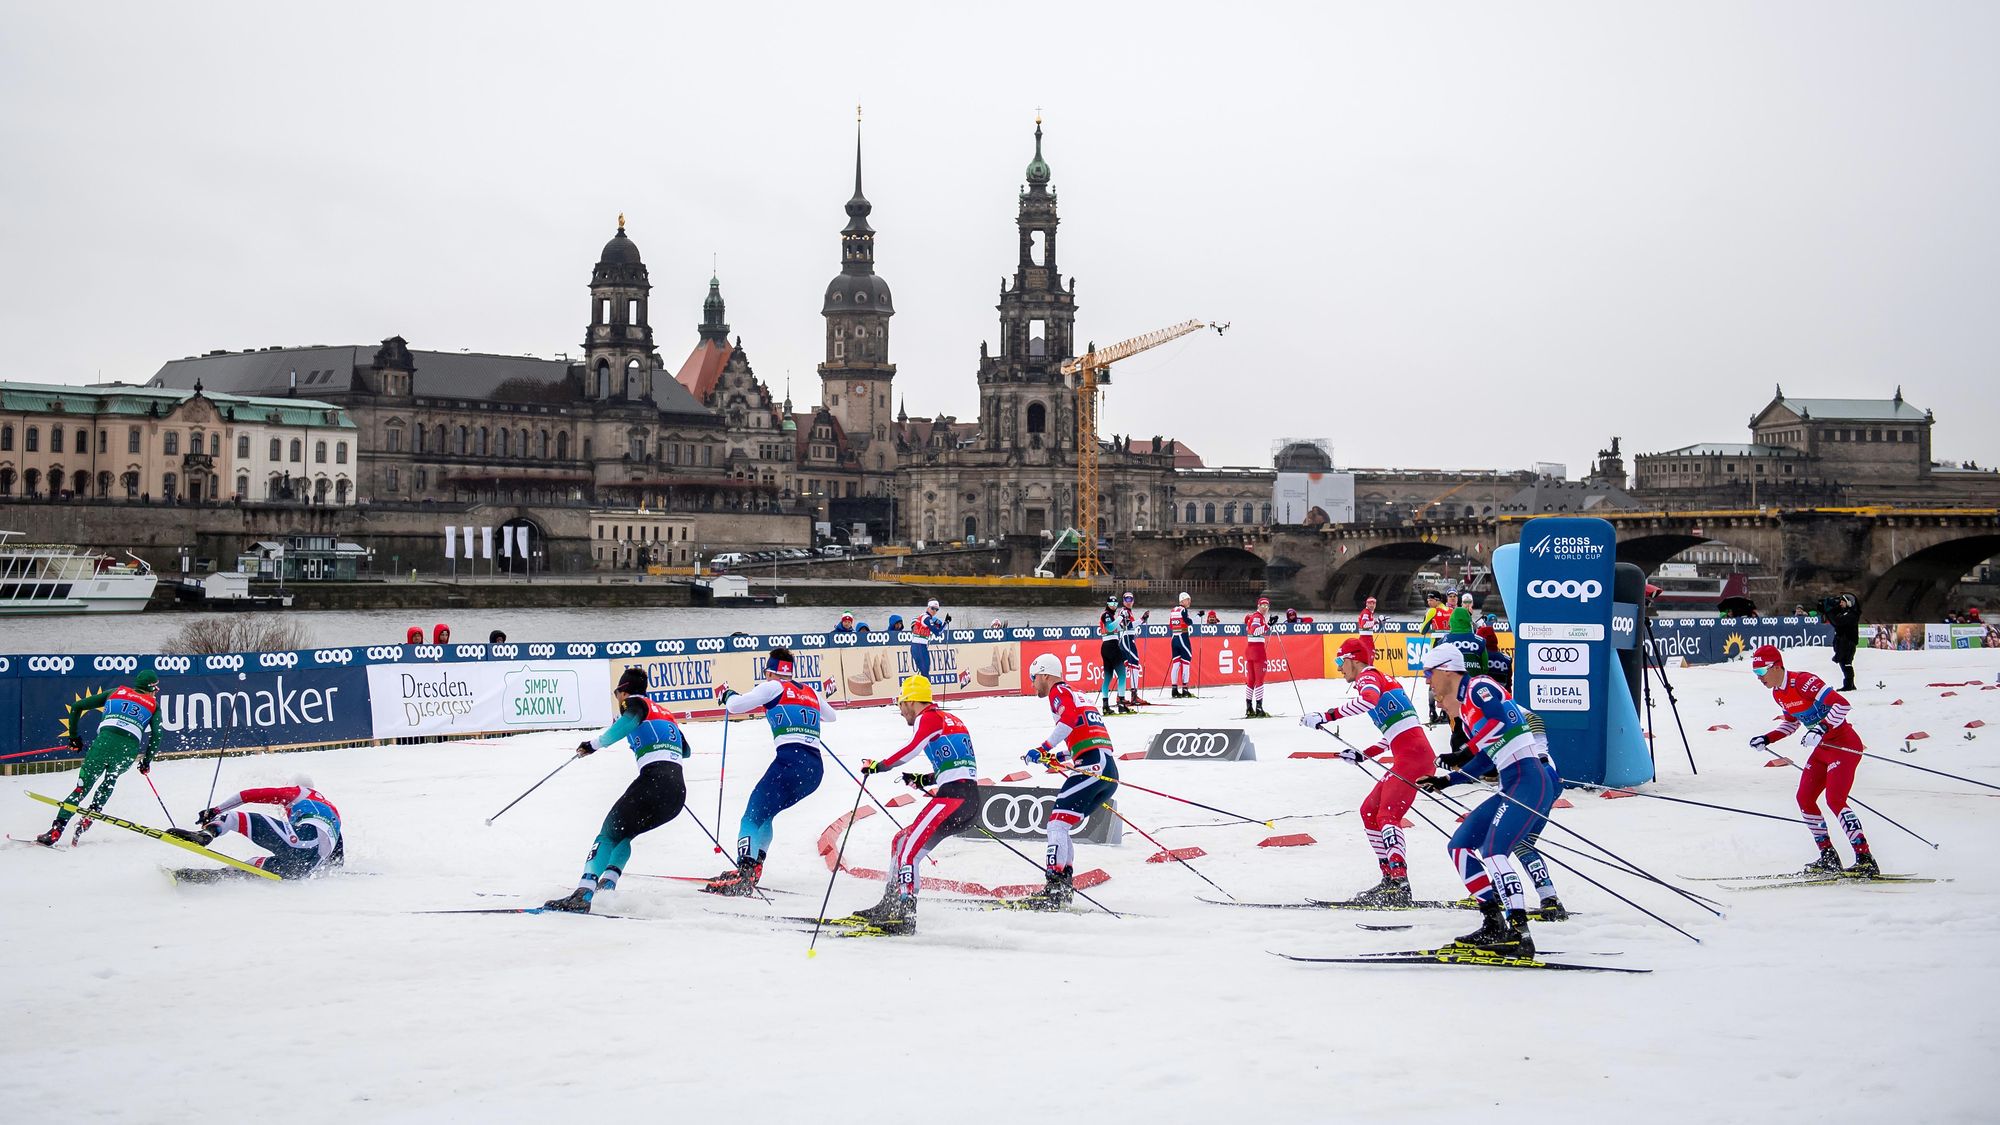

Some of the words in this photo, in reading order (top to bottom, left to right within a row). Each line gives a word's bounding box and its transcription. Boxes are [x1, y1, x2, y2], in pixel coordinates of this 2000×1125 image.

[1554, 537, 1590, 545] CROSS
[1554, 545, 1604, 554] COUNTRY
[1527, 580, 1602, 602] coop
[1407, 622, 1421, 631] coo
[1613, 616, 1633, 635] coop
[1659, 618, 1674, 628] coop
[1680, 618, 1695, 627] coop
[1700, 618, 1715, 627] coop
[1721, 617, 1736, 627] coop
[1742, 617, 1757, 626] coop
[1762, 617, 1778, 626] coop
[1783, 616, 1798, 625] coop
[1804, 616, 1819, 625] coop
[1043, 627, 1062, 639] coop
[1070, 626, 1090, 638] coop
[1149, 625, 1168, 636] coop
[1201, 624, 1217, 636] coop
[1224, 624, 1240, 635] coop
[1272, 624, 1287, 635] oop
[1293, 623, 1311, 634] coop
[1316, 622, 1333, 633] coop
[1339, 622, 1356, 633] coop
[1384, 622, 1401, 632] coop
[1493, 622, 1509, 633] coop
[833, 633, 857, 646] coop
[866, 632, 889, 644] coop
[898, 632, 912, 642] coo
[953, 630, 974, 642] coop
[983, 629, 1004, 641] coop
[1012, 628, 1035, 640] coop
[1750, 629, 1827, 648] sunmaker
[1935, 634, 1950, 643] IDEAL
[697, 638, 725, 652] coop
[733, 636, 759, 650] coop
[768, 635, 792, 649] coop
[802, 634, 825, 647] coop
[1454, 641, 1479, 651] oop
[1643, 630, 1701, 656] nmaker
[414, 645, 443, 660] coop
[456, 645, 486, 660] coop
[492, 644, 518, 659] coop
[529, 644, 555, 658] coop
[567, 643, 596, 658] coop
[606, 642, 641, 656] coop
[655, 640, 685, 654] coop
[314, 649, 353, 665] coop
[367, 646, 403, 661] coop
[1374, 649, 1385, 660] ST
[1387, 648, 1403, 660] RUN
[28, 656, 74, 674] coop
[94, 656, 137, 674] coop
[154, 656, 190, 674] coop
[206, 654, 244, 671] coop
[260, 652, 298, 668] coop
[753, 657, 766, 681] LE
[793, 651, 821, 679] YÈRE
[897, 651, 909, 673] LE
[1238, 656, 1287, 676] Spasse
[1488, 660, 1508, 671] oop
[648, 656, 712, 688] GRUYÈRE
[401, 672, 473, 698] Dresden.
[525, 679, 558, 694] SIMPLY
[649, 689, 710, 701] ITZERLAND
[1550, 687, 1582, 696] IDEAL
[145, 676, 338, 732] unmaker
[514, 697, 566, 716] SAXONY.
[1537, 697, 1582, 706] Versicherung
[1784, 700, 1803, 709] Sparkasse
[121, 702, 140, 716] 13
[1380, 700, 1397, 717] 14
[799, 707, 818, 727] 17
[668, 724, 677, 742] 3
[936, 744, 951, 761] 18
[1848, 820, 1861, 831] 21
[1384, 836, 1396, 848] 14
[739, 845, 749, 856] 17
[901, 872, 912, 884] 18
[1532, 869, 1548, 882] 20
[1507, 882, 1523, 894] 19
[1456, 956, 1546, 967] FISCHER
